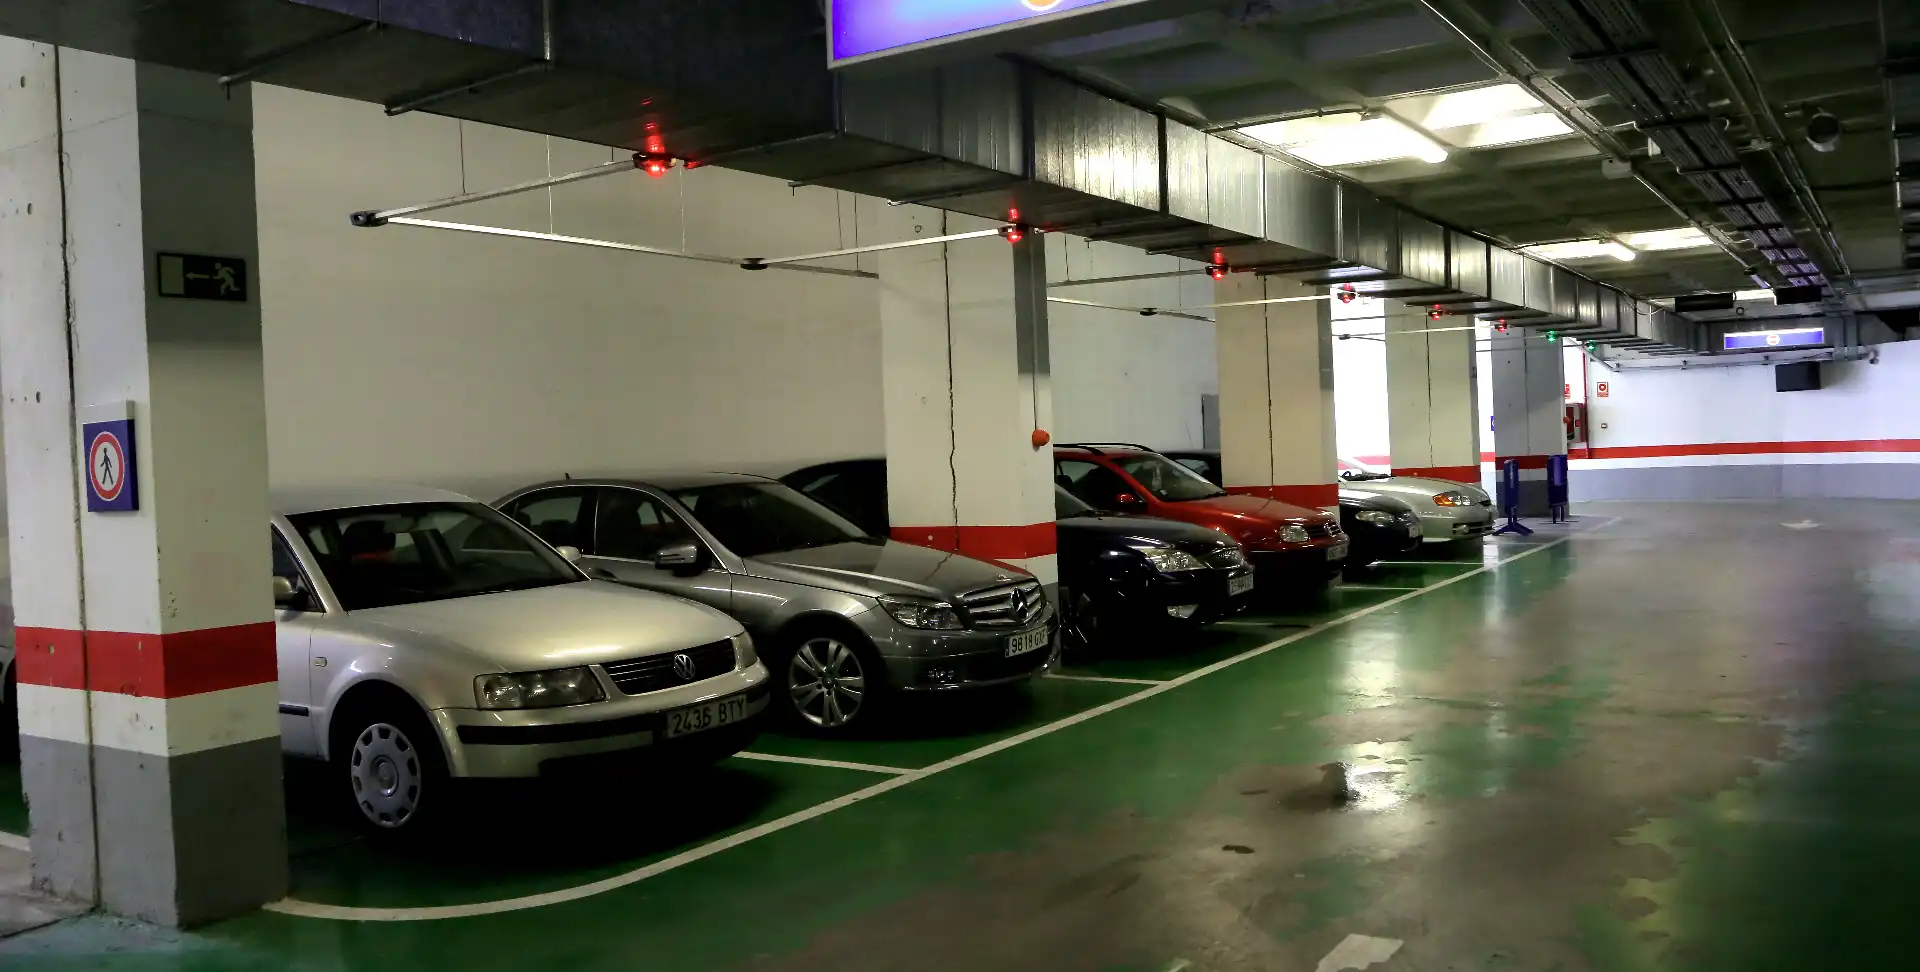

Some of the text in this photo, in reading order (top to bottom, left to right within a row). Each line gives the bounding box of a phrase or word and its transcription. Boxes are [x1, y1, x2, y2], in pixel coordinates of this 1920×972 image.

[1011, 634, 1033, 653] 9818
[672, 697, 745, 735] 2436 BTY
